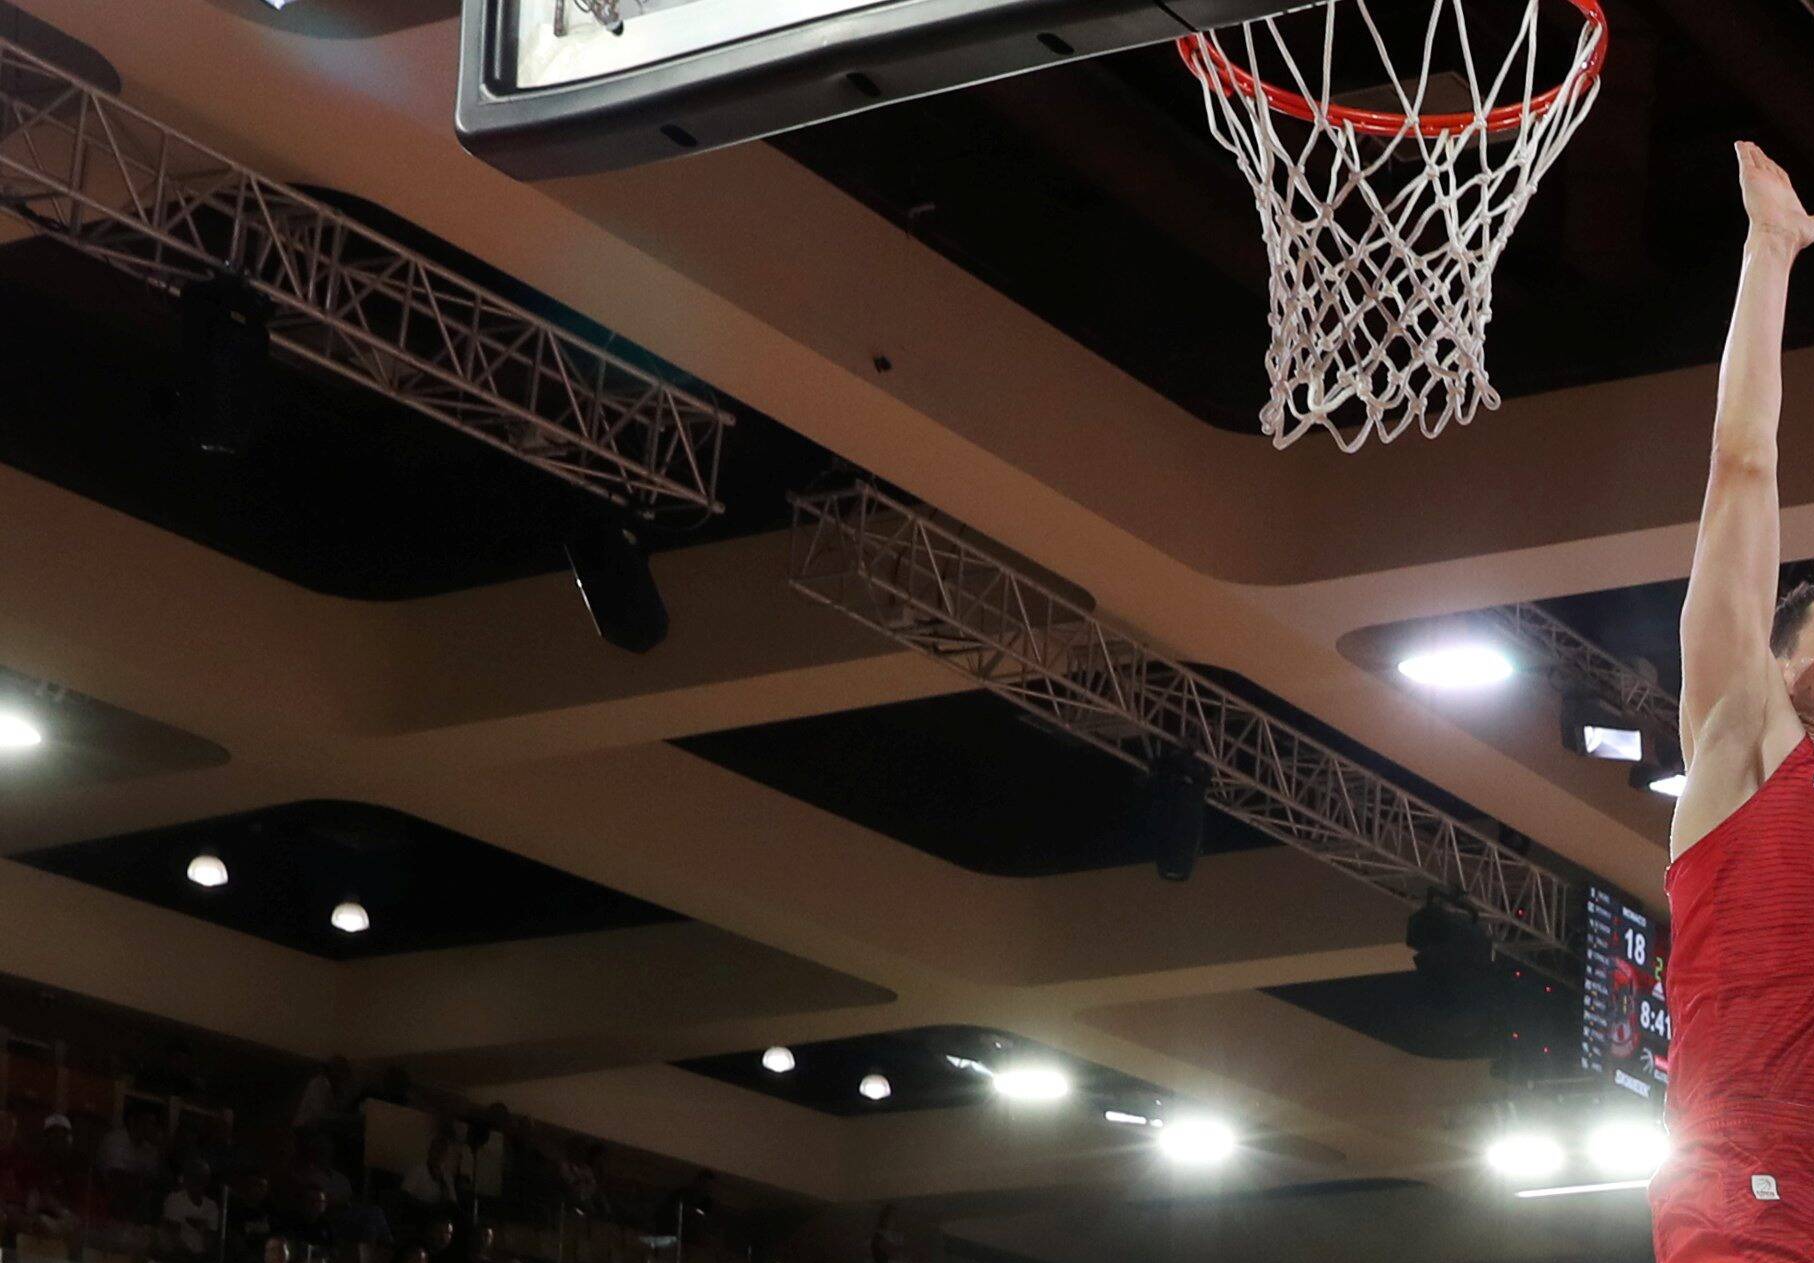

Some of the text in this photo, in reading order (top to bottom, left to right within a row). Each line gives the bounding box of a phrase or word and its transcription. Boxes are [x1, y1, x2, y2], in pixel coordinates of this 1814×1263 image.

[1623, 928, 1646, 967] 18
[1654, 956, 1664, 983] 2
[1639, 1000, 1672, 1041] 8:41
